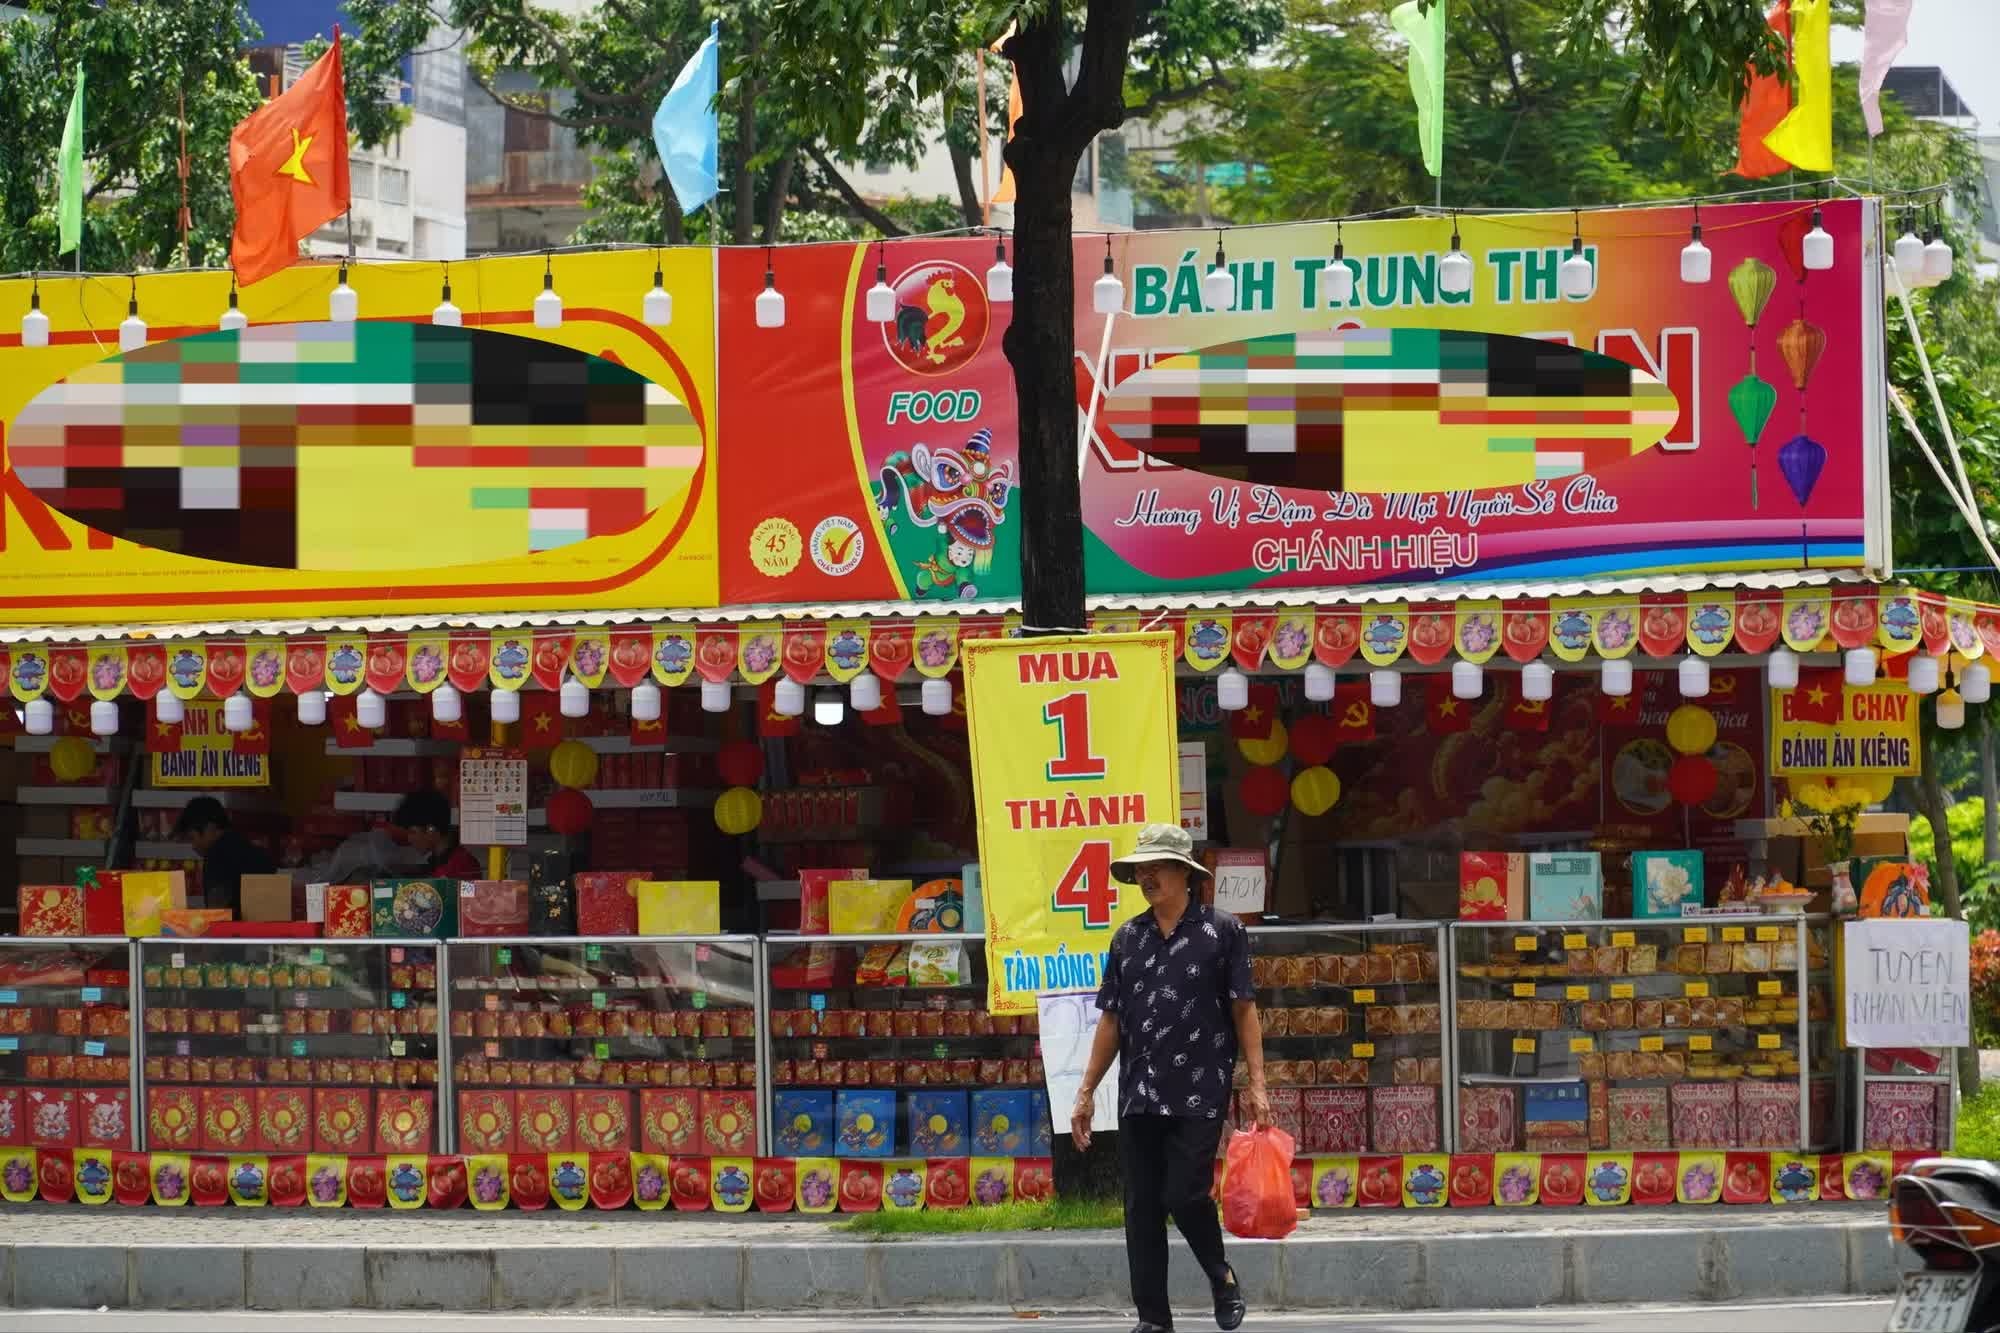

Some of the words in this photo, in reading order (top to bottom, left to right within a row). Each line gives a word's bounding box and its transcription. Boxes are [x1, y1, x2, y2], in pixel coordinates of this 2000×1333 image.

[887, 390, 982, 424] FOOD
[1115, 488, 1201, 535] Hương
[1210, 486, 1240, 528] Vị
[1248, 485, 1316, 527] Đậm
[1323, 491, 1373, 520] Đà
[1383, 492, 1437, 524] Mọi
[1445, 489, 1513, 526] Người
[1562, 474, 1618, 513] Chia
[765, 533, 787, 553] 45
[1252, 529, 1382, 572] CHÁNH
[1391, 527, 1479, 574] HIỆU
[1018, 651, 1119, 684] MUA
[1852, 692, 1909, 722] CHAY
[1043, 691, 1106, 781] 1
[1782, 731, 1827, 768] BÁNH
[1832, 731, 1856, 768] ĂN
[1861, 731, 1910, 768] KIÊNG
[1005, 792, 1146, 830] THÀNH
[1052, 840, 1119, 931] 4
[1003, 949, 1041, 992] TÂN
[1043, 942, 1096, 990] ĐỒNG
